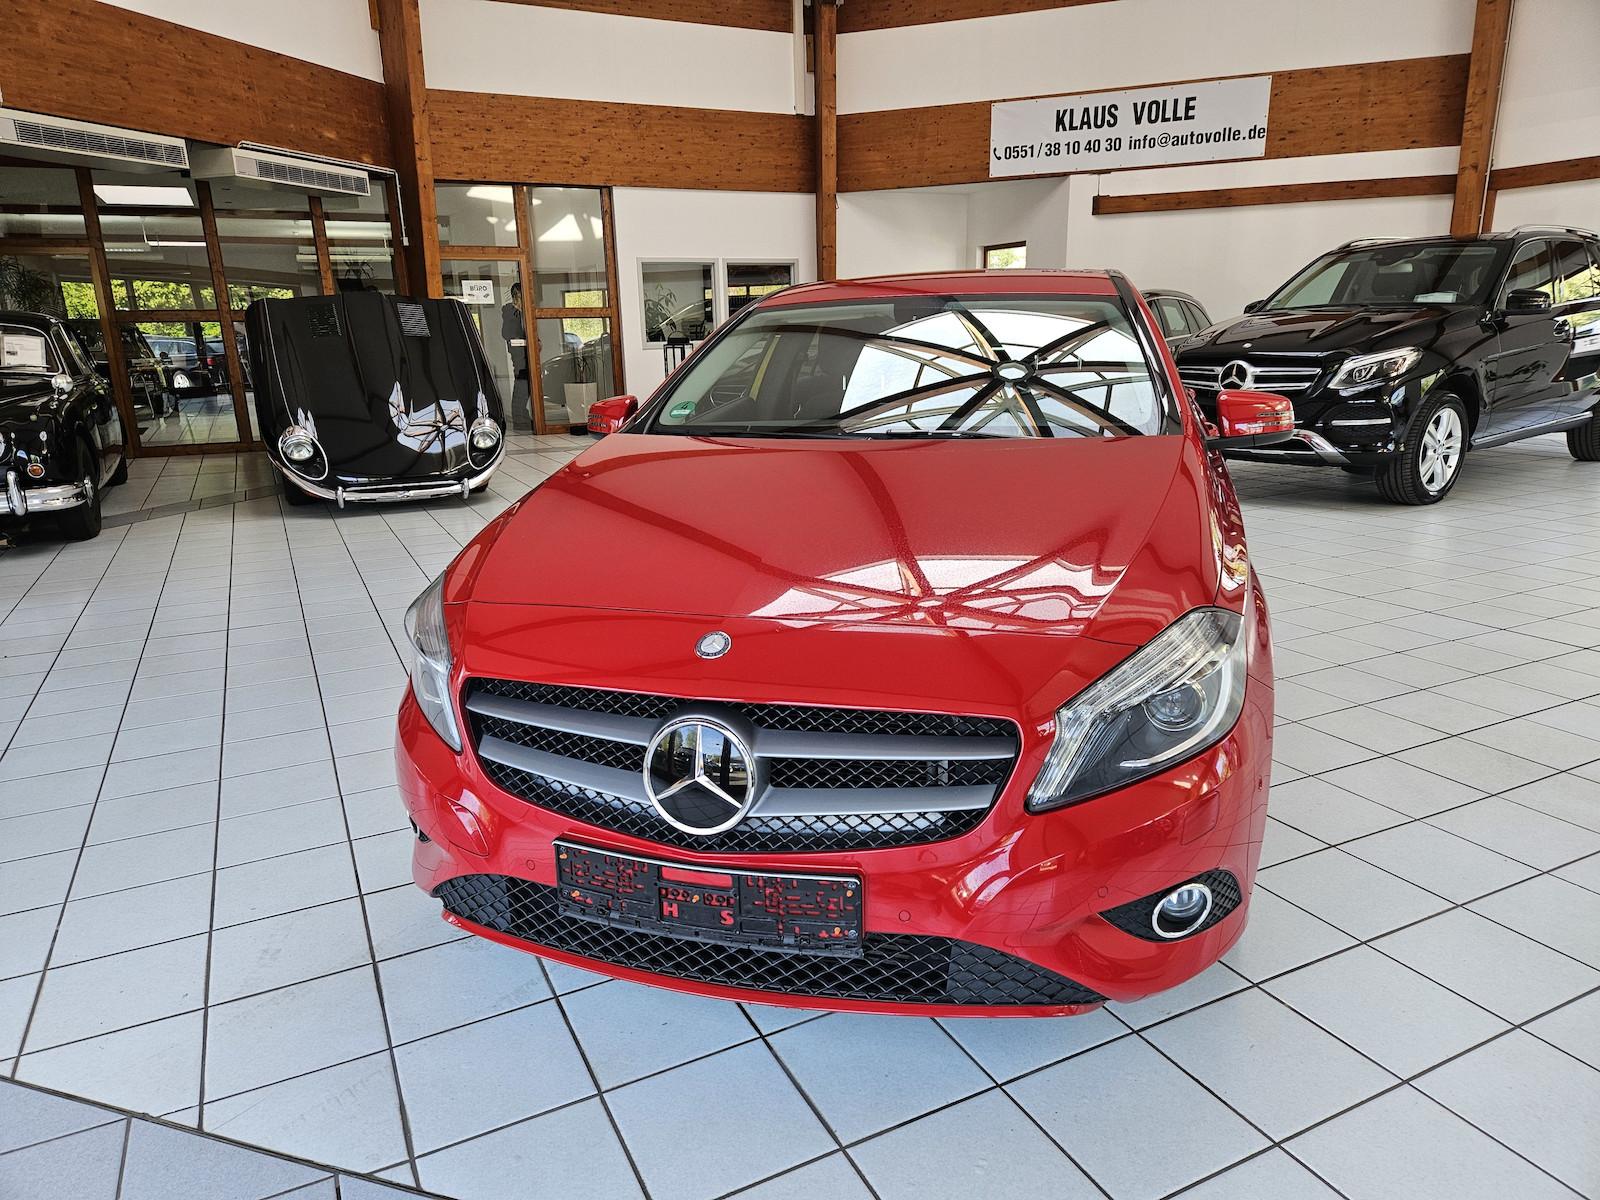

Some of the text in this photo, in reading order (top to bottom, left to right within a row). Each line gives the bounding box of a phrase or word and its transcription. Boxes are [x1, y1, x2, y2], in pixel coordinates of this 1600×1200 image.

[1055, 96, 1197, 132] KLAUS VOLLE
[1064, 140, 1081, 155] 10
[1084, 138, 1101, 153] 40
[1104, 137, 1122, 152] 30
[1128, 125, 1266, 150] info@autovolle.de
